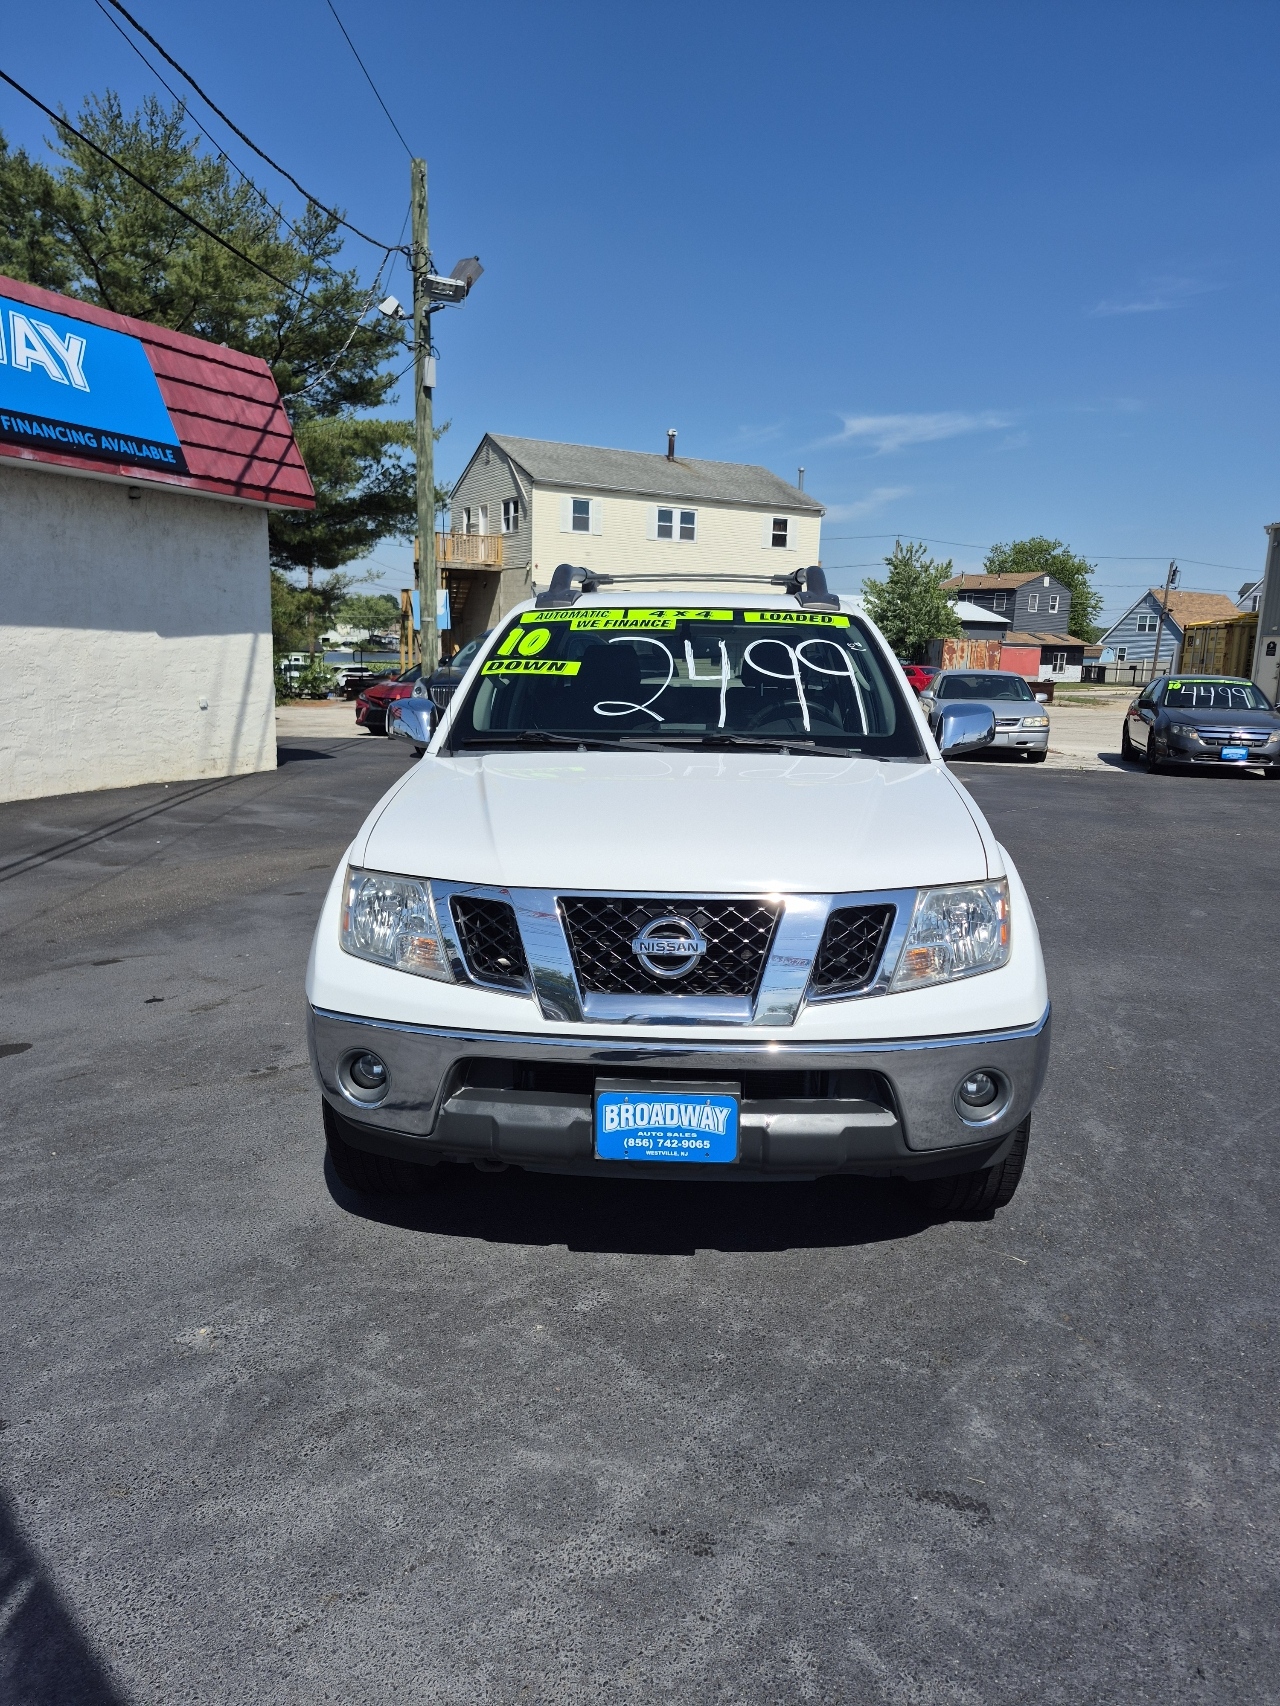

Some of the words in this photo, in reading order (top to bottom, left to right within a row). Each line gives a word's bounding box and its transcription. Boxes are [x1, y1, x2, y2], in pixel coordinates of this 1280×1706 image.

[0, 309, 90, 393] AY
[1, 415, 98, 448] FINANCING
[101, 436, 176, 463] AVAILABLE
[535, 610, 609, 620] AUTOMATIC
[576, 619, 600, 628] WE
[603, 619, 670, 628] FINANCE
[759, 612, 833, 624] LOADED
[497, 628, 551, 656] 10
[486, 661, 568, 672] DOWN
[593, 636, 867, 735] 2499
[1181, 686, 1251, 708] 4499
[640, 942, 698, 952] NISSAN
[603, 1103, 731, 1135] BROADWAY
[624, 1138, 653, 1149] (856)
[657, 1139, 710, 1149] 742-9065
